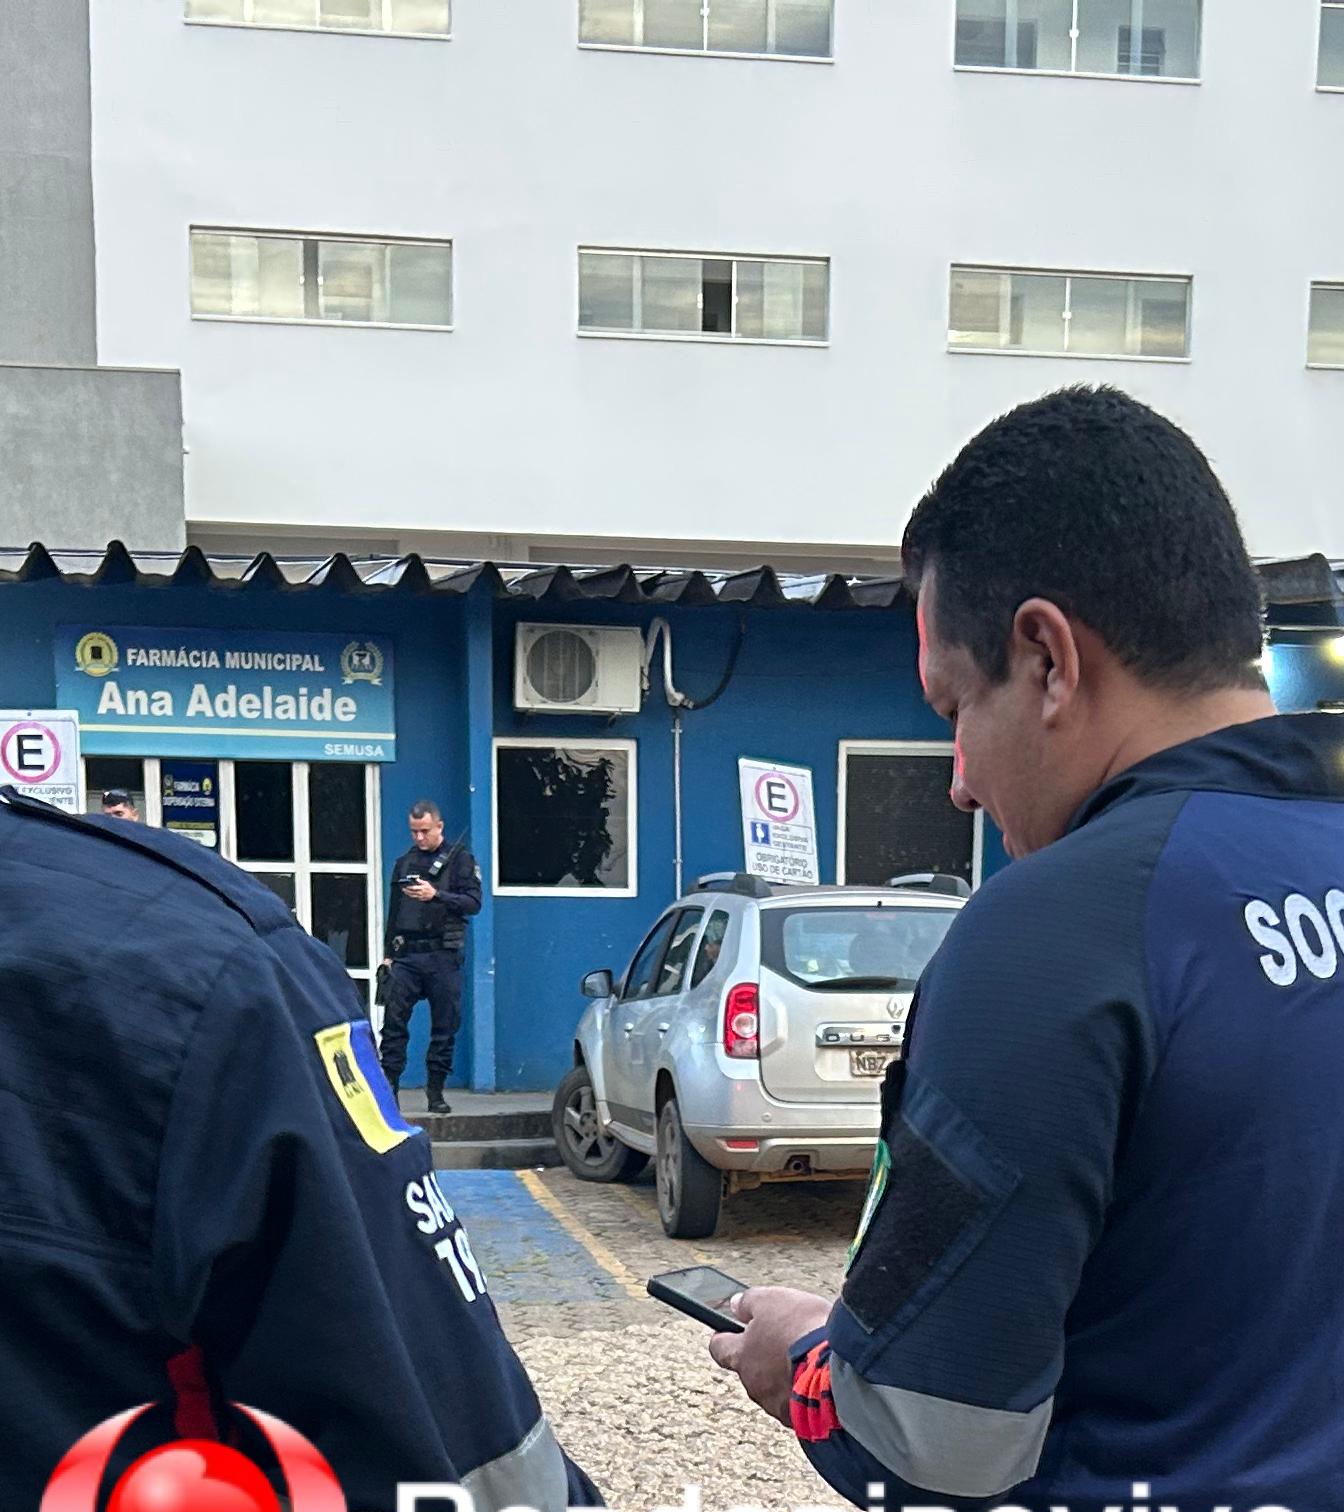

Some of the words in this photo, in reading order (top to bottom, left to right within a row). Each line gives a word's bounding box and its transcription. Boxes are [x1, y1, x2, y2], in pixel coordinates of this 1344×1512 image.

[127, 646, 220, 668] FARMÁCIA
[225, 650, 325, 672] MUNICIPAL
[97, 681, 173, 716] Ana
[186, 683, 356, 721] Adelaide
[16, 734, 45, 771] E
[324, 743, 384, 757] SEMUSA
[766, 781, 788, 813] E
[825, 1033, 891, 1042] DUS
[856, 1057, 887, 1073] NBZ
[434, 1228, 487, 1302] 19
